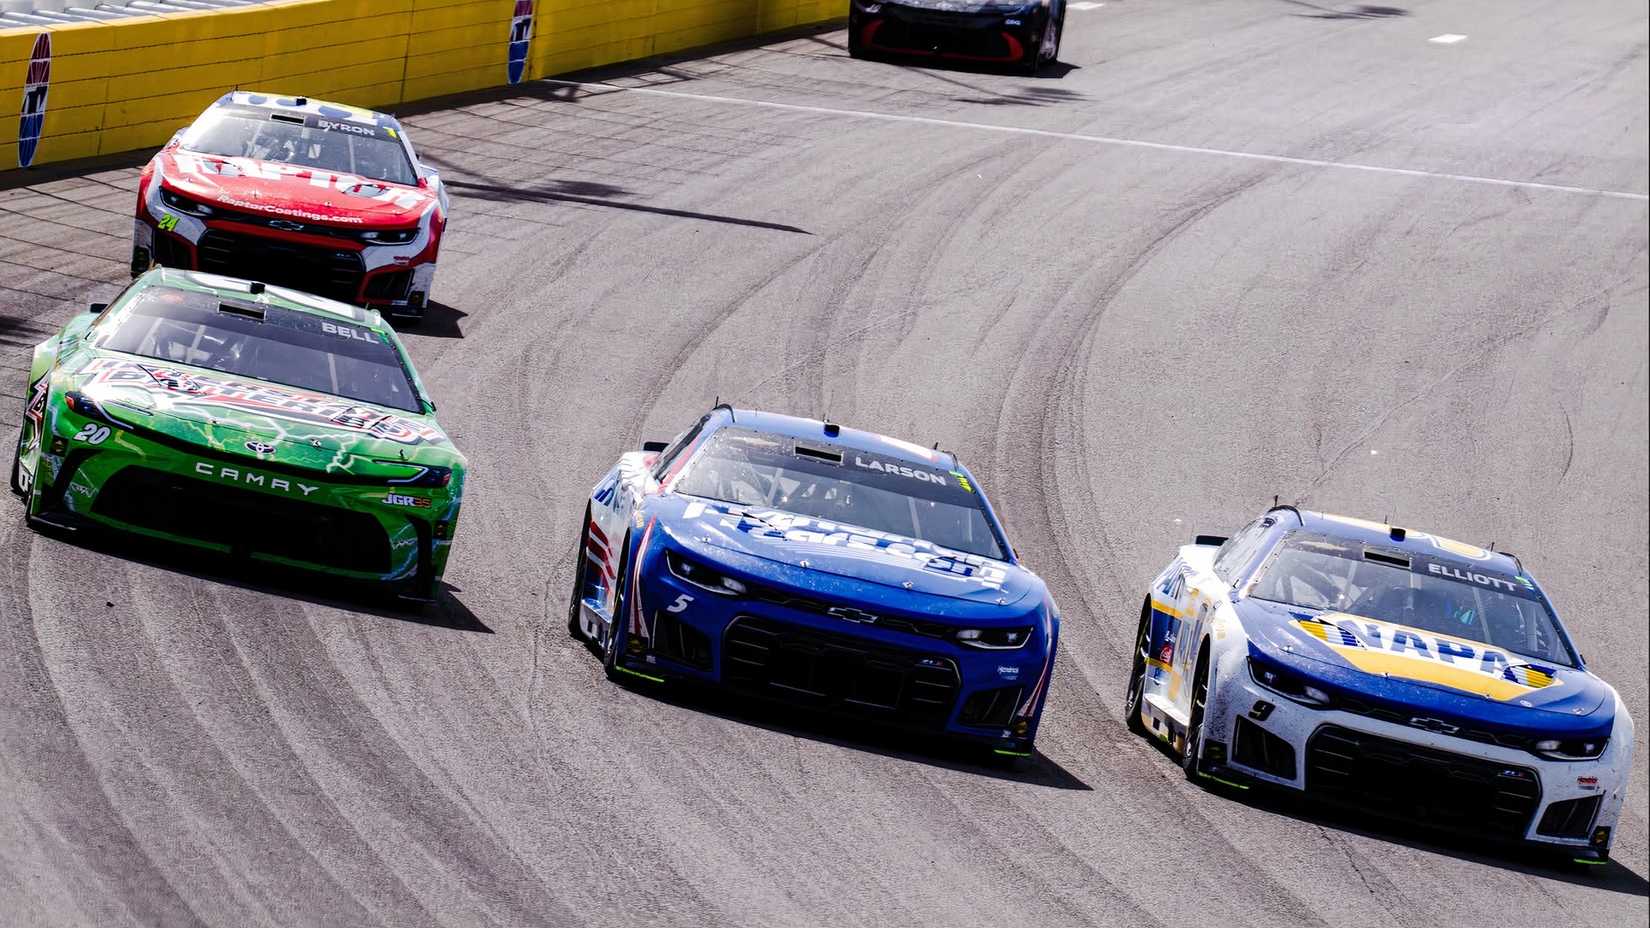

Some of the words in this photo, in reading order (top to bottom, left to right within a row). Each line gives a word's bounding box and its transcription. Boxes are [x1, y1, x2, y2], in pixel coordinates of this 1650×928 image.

[318, 120, 375, 136] BYRON
[217, 193, 363, 223] RaptorCoatings.com
[158, 212, 180, 232] 24
[321, 322, 379, 344] BELL
[73, 422, 111, 445] 20
[195, 462, 320, 496] CAMRY
[856, 456, 947, 486] LARSON
[1428, 563, 1517, 592] ELLIOTT
[666, 593, 695, 613] 5
[1337, 618, 1518, 682] NAPA
[1248, 700, 1276, 721] 9
